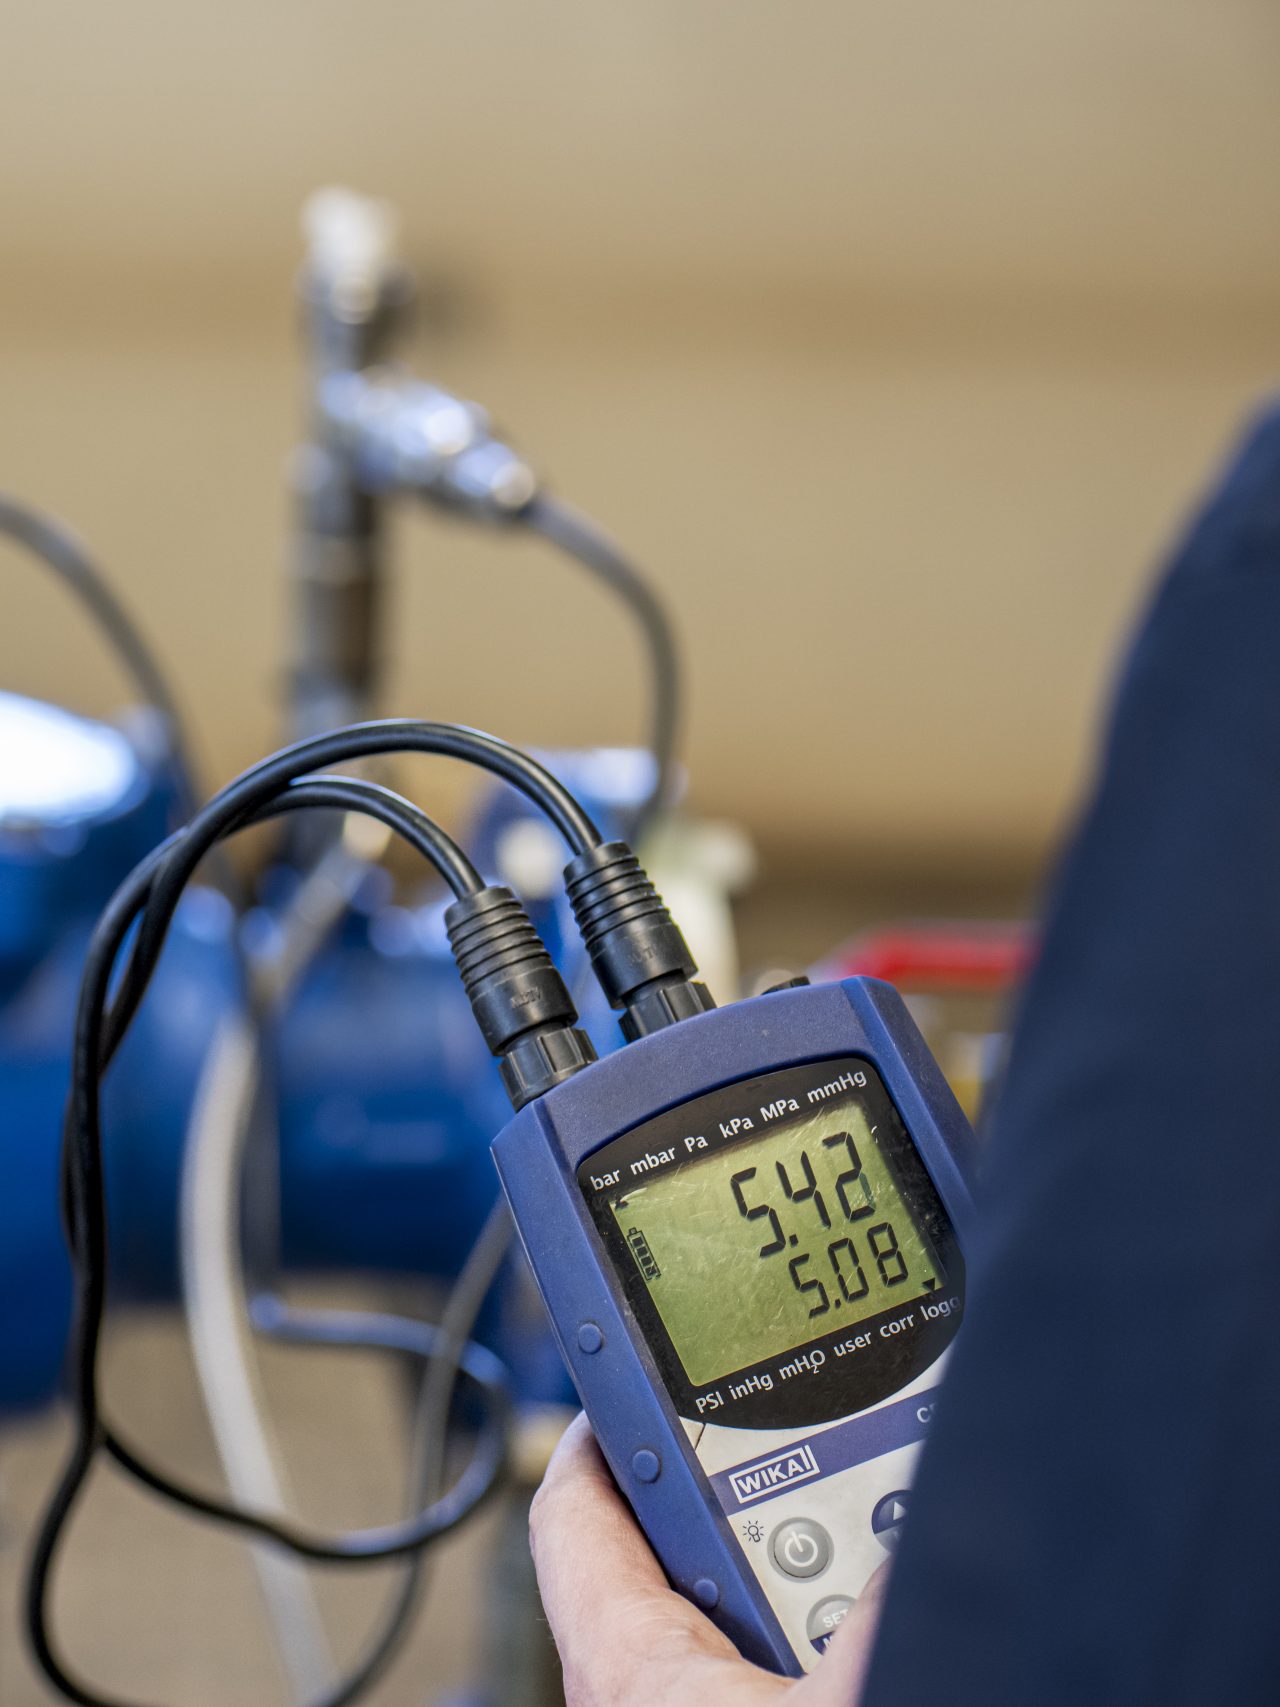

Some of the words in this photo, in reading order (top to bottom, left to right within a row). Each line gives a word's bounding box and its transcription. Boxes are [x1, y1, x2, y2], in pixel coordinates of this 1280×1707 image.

[589, 1169, 621, 1192] bar
[630, 1146, 676, 1178] mbar
[683, 1133, 709, 1153] Pa
[719, 1116, 755, 1139] kPa
[759, 1097, 800, 1122] MPa
[807, 1069, 868, 1104] mmHg
[730, 1130, 876, 1259] 5.42
[788, 1222, 909, 1319] 5.08
[695, 1390, 725, 1414] PSI
[729, 1371, 774, 1400] inHg
[833, 1330, 873, 1358] user
[879, 1314, 915, 1339] corr
[736, 1456, 807, 1496] WIKA
